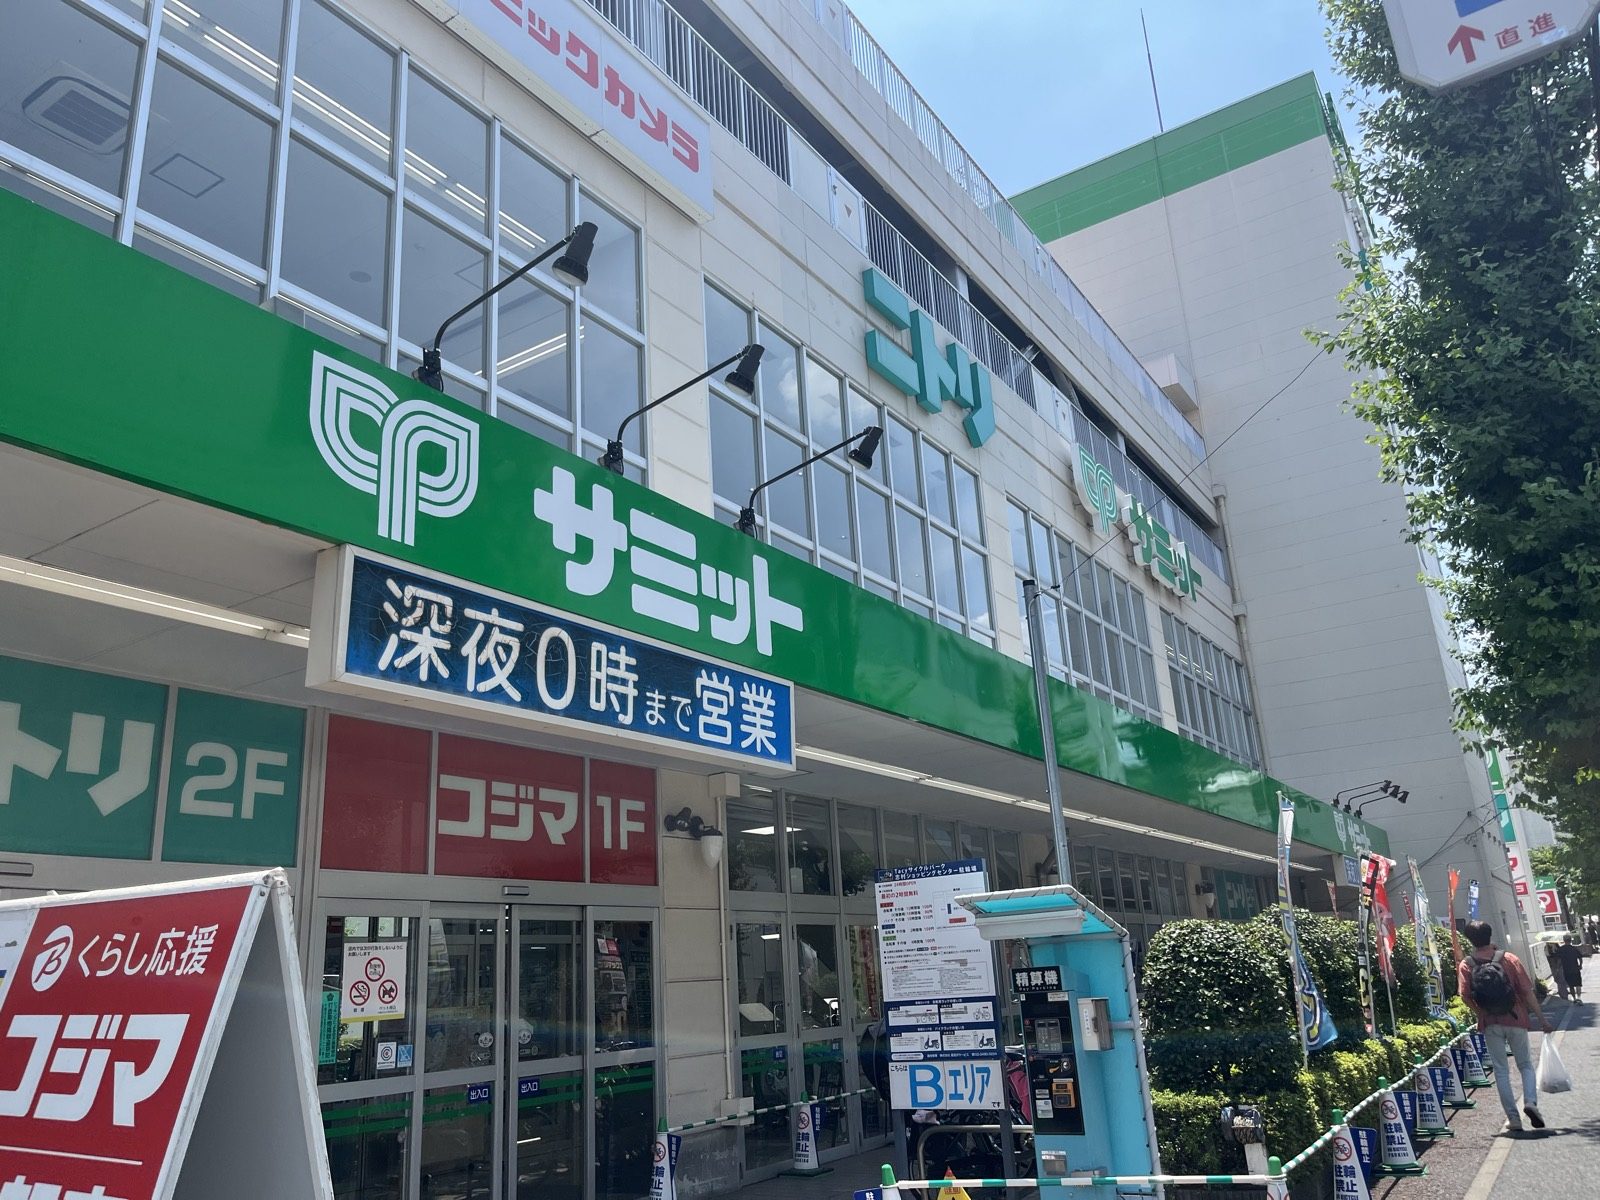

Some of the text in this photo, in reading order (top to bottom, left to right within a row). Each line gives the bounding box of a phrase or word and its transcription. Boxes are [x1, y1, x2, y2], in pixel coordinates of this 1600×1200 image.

[1495, 13, 1557, 49] 直進
[863, 268, 996, 448] ニトリ
[534, 466, 803, 657] サミット
[1121, 494, 1203, 602] サミット
[180, 741, 288, 819] 2F
[438, 774, 646, 850] コジマ 1F
[78, 924, 219, 978] くらし応援
[1015, 970, 1059, 987] 精算機
[0, 1014, 190, 1127] コジマ
[890, 1064, 908, 1072] こちらは
[470, 1088, 489, 1100] 出入口
[521, 1082, 538, 1093] 出入口
[1386, 1134, 1407, 1146] 禁止
[1335, 1164, 1356, 1178] 駐輪
[1335, 1179, 1358, 1193] 禁止
